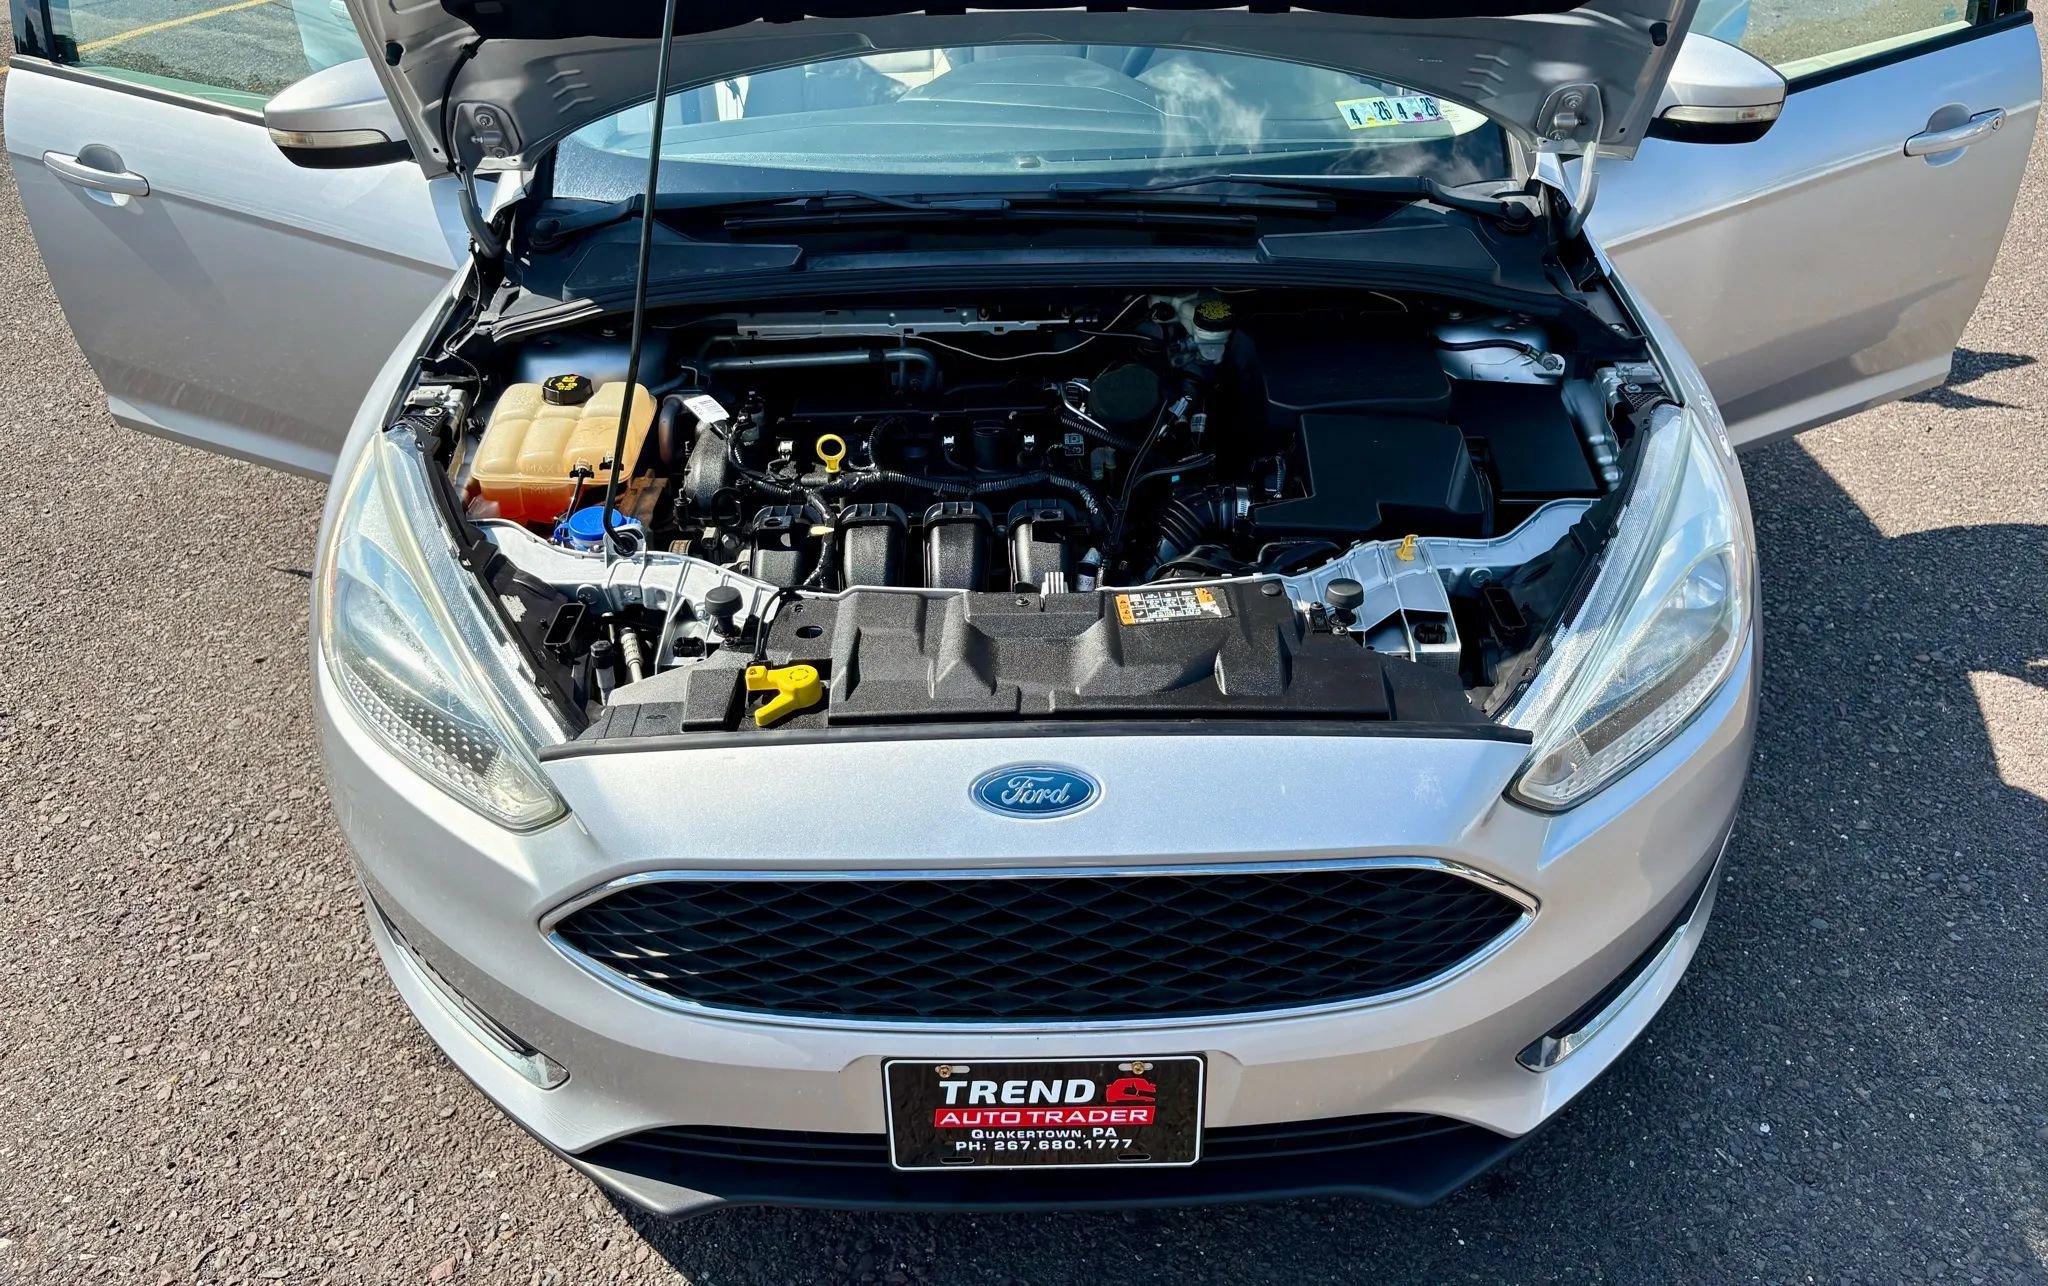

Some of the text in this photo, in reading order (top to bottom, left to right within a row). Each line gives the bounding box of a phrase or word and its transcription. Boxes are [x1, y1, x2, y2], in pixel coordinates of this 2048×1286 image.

[1349, 101, 1393, 125] 4 26
[1397, 102, 1408, 119] 4
[1420, 97, 1438, 117] 26
[1001, 775, 1072, 805] Ford
[939, 1079, 1096, 1105] TREND
[940, 1109, 1148, 1125] AUTO TRADER
[1092, 1127, 1117, 1138] PA
[955, 1139, 1133, 1151] PH: 267.680.1777
